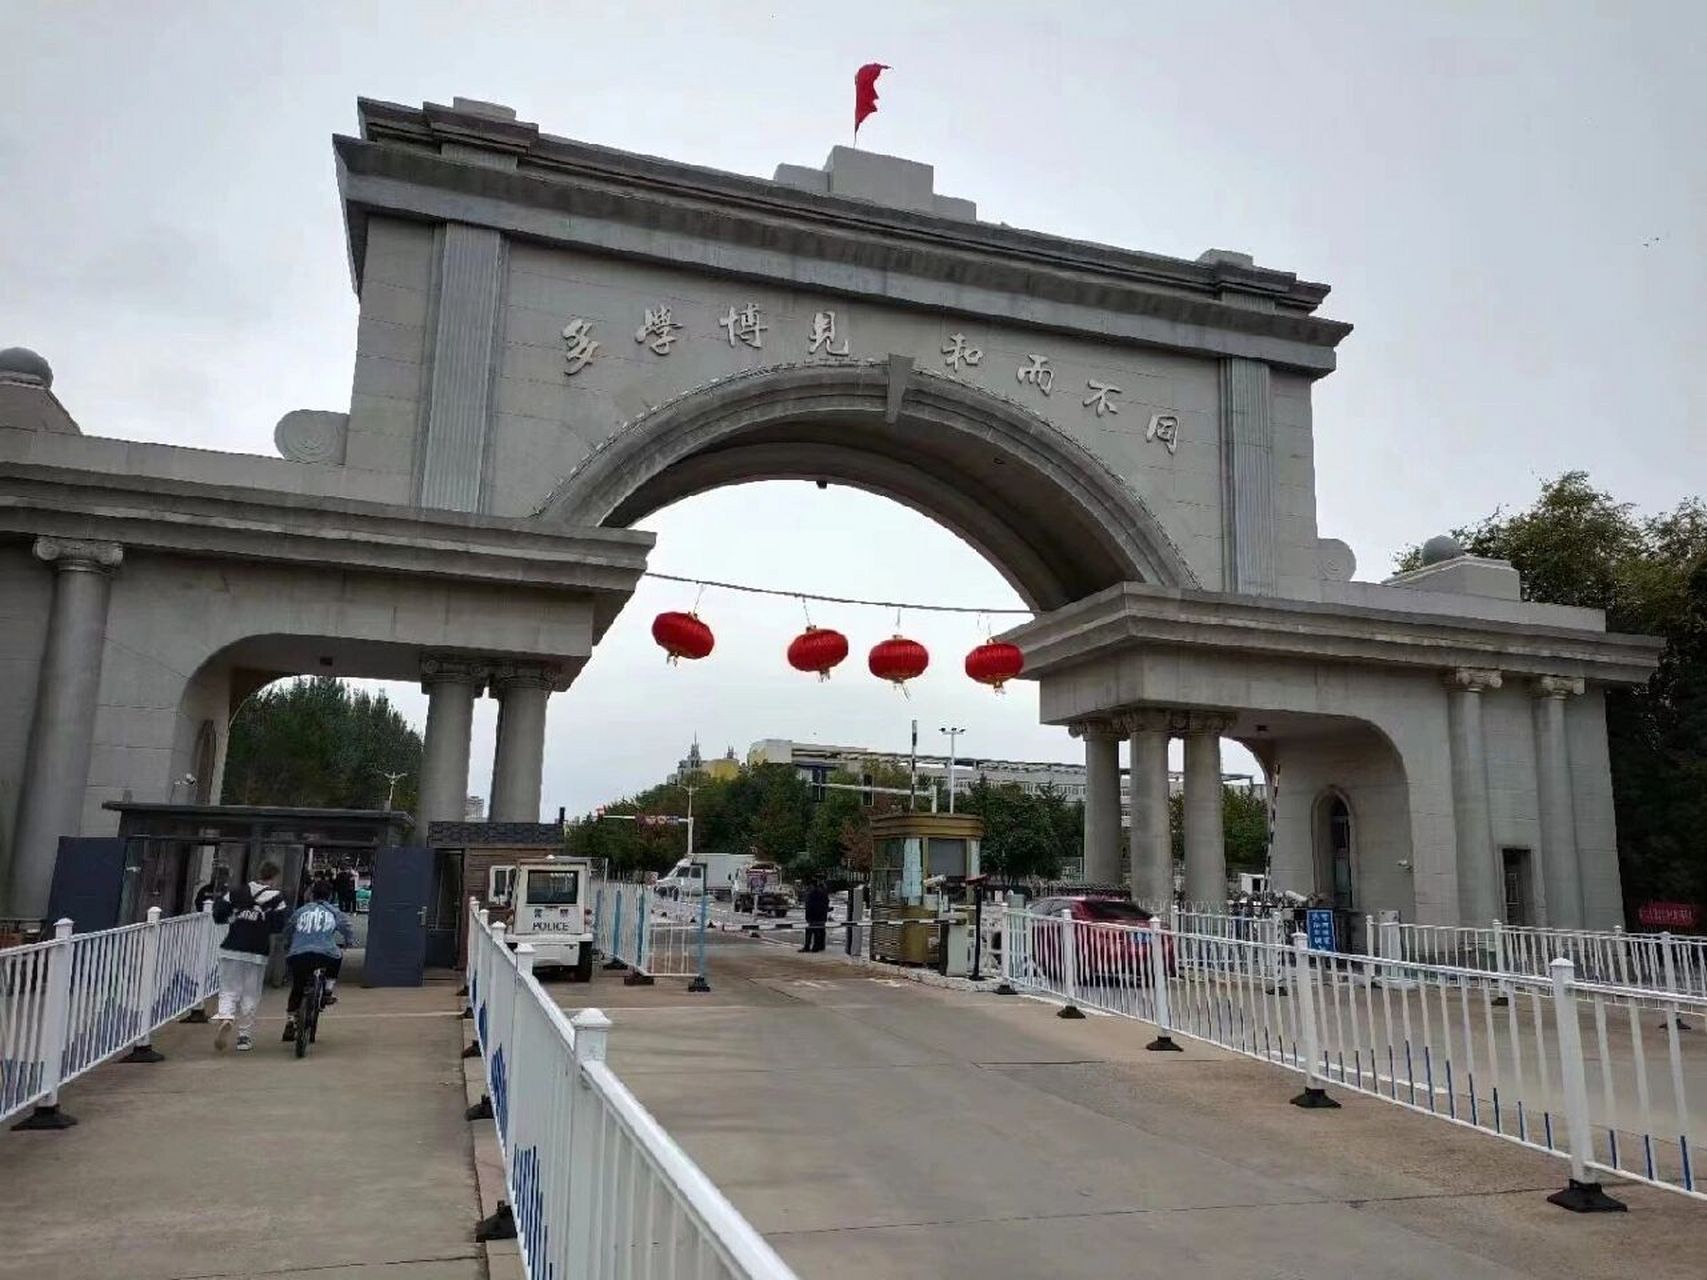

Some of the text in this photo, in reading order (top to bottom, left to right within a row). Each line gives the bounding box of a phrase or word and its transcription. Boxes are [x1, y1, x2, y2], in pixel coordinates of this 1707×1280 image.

[941, 332, 1180, 455] 和而不同
[532, 921, 569, 932] POLICE
